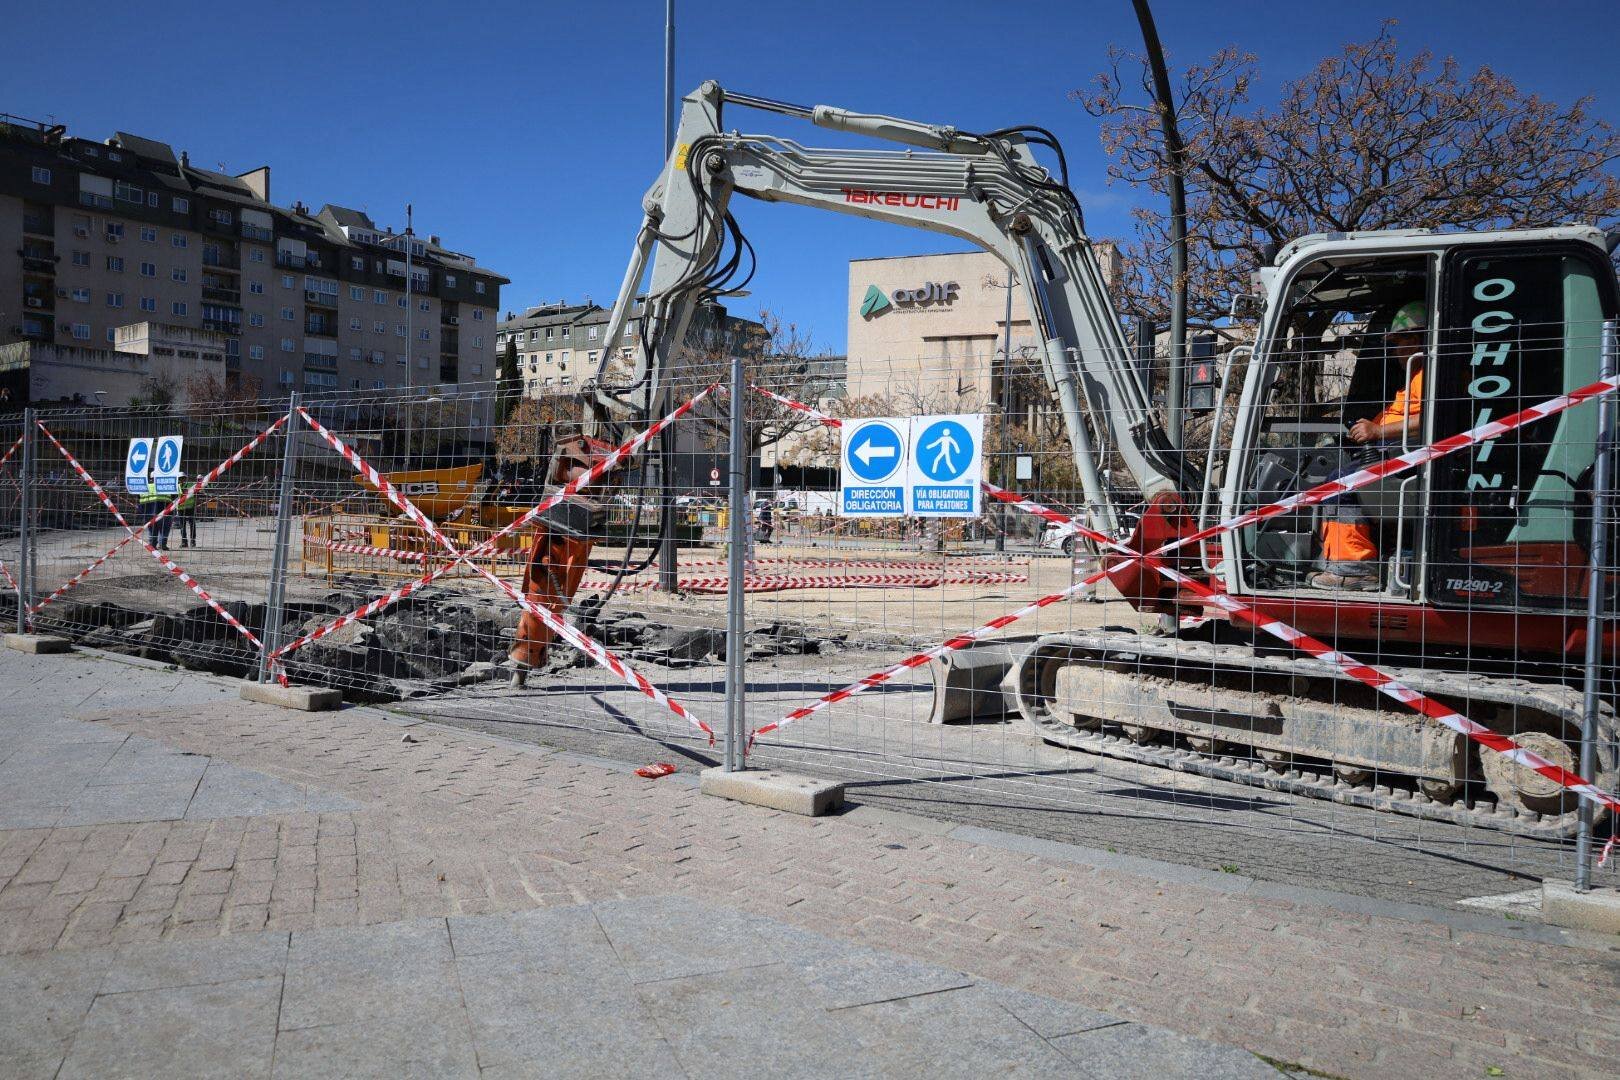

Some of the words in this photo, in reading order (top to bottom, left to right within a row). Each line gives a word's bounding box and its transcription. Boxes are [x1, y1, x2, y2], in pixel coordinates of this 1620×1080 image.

[892, 281, 960, 304] adif
[1467, 261, 1516, 492] OCHOLIN
[851, 488, 896, 499] DIRECCIÓN
[916, 488, 927, 499] VÍA
[928, 488, 970, 499] OBLIGATORIA
[846, 500, 902, 511] OBLIGATORIA
[917, 500, 934, 510] PARA
[935, 500, 968, 510] PEATONES
[1446, 578, 1503, 593] TB290-2
